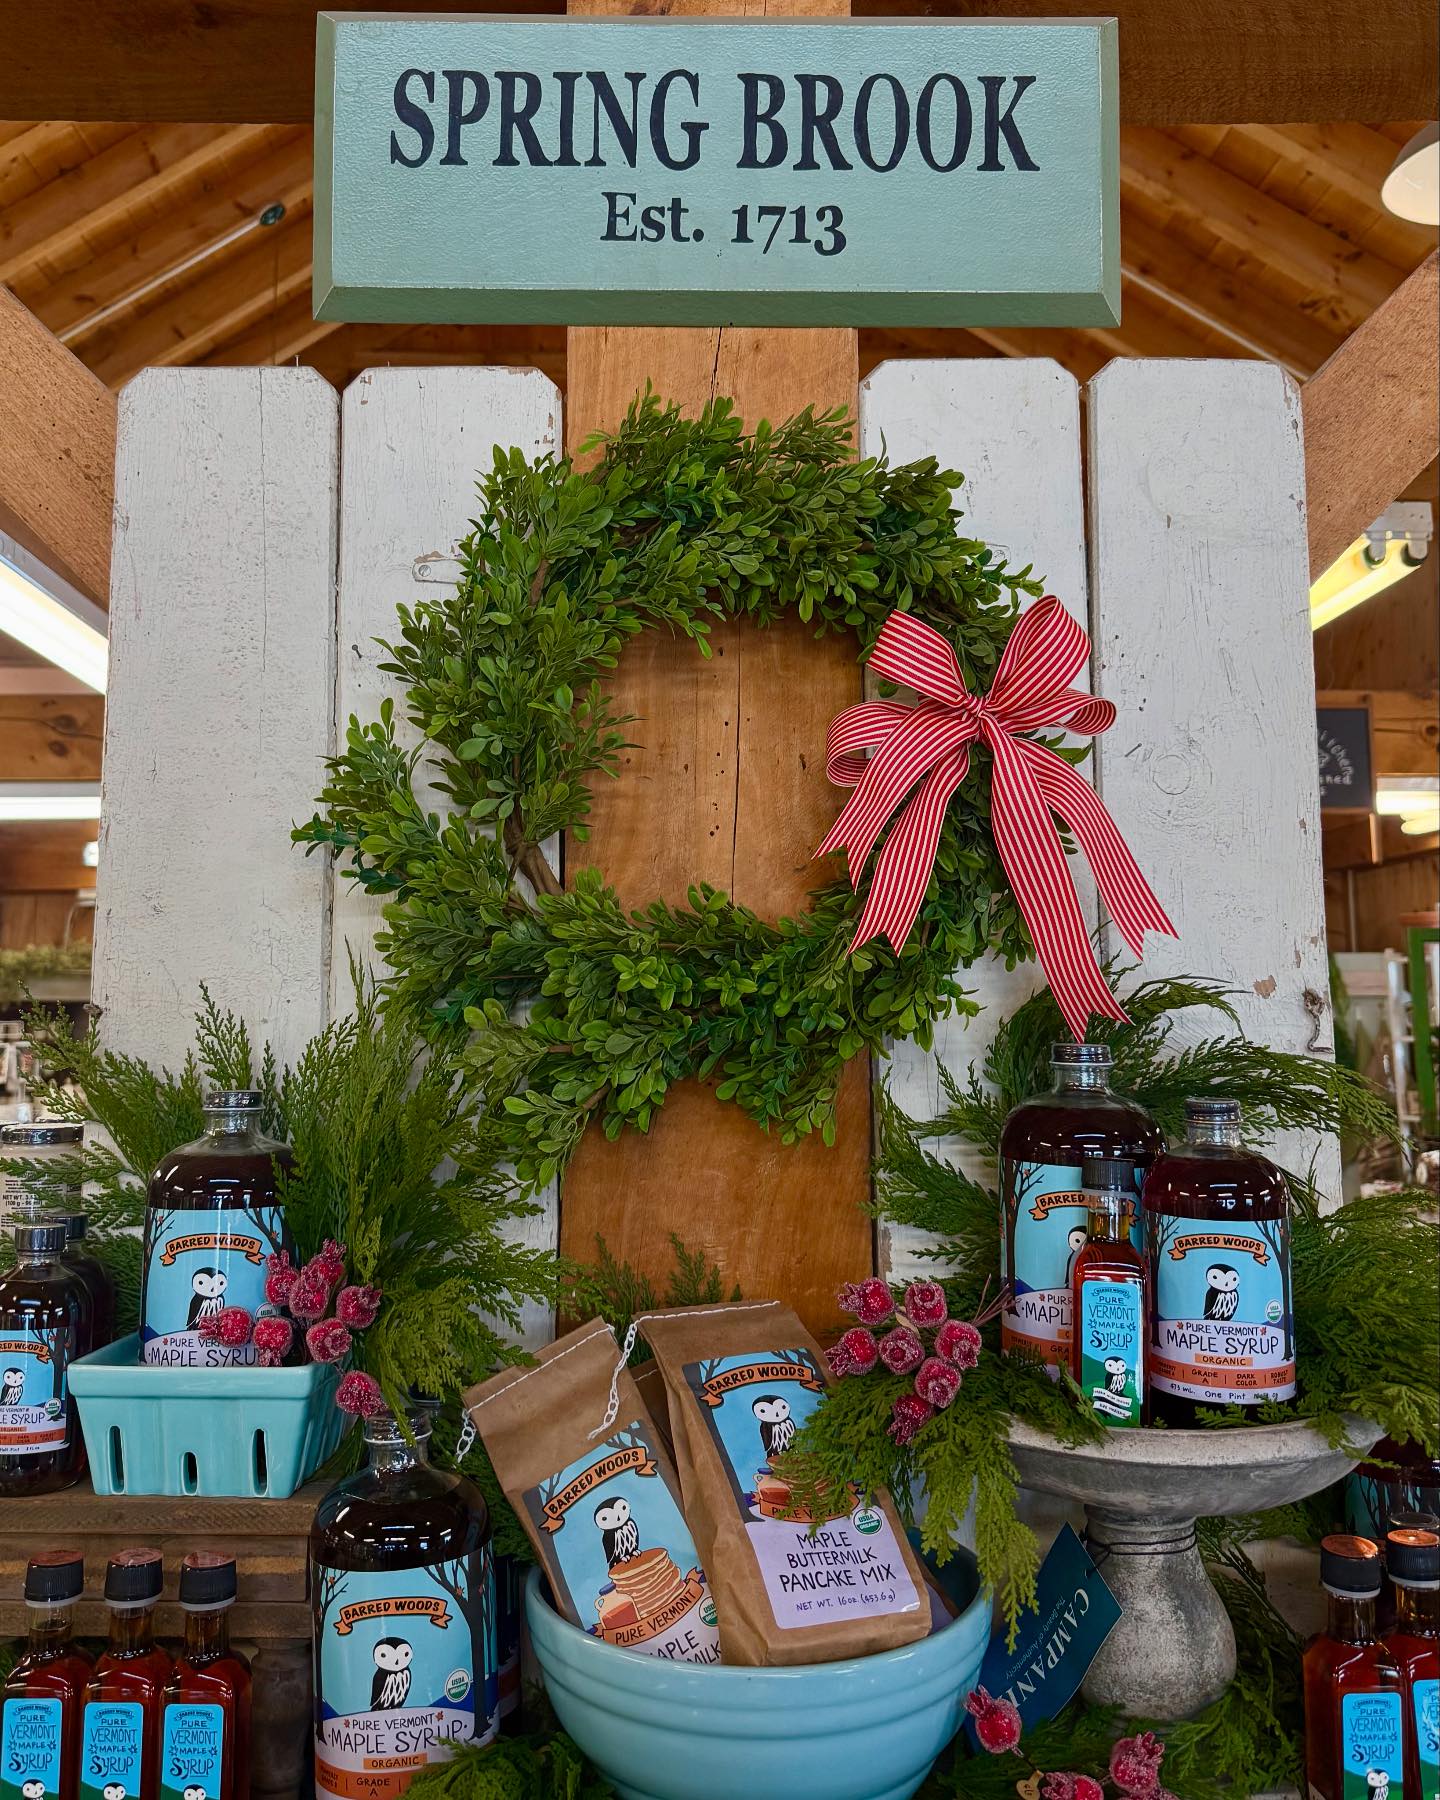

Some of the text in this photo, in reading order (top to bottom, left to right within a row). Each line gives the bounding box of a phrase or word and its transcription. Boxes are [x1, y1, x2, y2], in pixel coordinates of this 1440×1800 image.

[391, 68, 1040, 172] SPRING BROOK
[600, 191, 847, 256] Est. 1713
[1040, 1193, 1086, 1207] BARRED
[168, 1236, 256, 1252] BARRED WOODS
[1178, 1236, 1261, 1251] BARRED WOODS
[1099, 1296, 1124, 1304] PURE
[1025, 1300, 1073, 1326] MAPL
[1088, 1303, 1136, 1321] VERMONT
[1098, 1321, 1125, 1329] MAPLE
[1186, 1321, 1260, 1337] PURE VERMONT
[14, 1341, 45, 1353] WOODS
[169, 1338, 194, 1347] PURE
[1090, 1330, 1133, 1351] SYRUP
[1166, 1328, 1279, 1355] MAPLE SYRUP
[150, 1347, 256, 1367] MAPLE SYRU
[1202, 1355, 1247, 1366] ORGANIC
[708, 1366, 806, 1392] BARRED WOODS
[1191, 1368, 1219, 1378] GRADE
[1204, 1390, 1222, 1399] One
[1229, 1392, 1246, 1400] Pint
[11, 1411, 46, 1425] SYRUP
[548, 1450, 640, 1515] BARRED WOODS
[796, 1531, 852, 1549] MAPLE
[786, 1546, 878, 1569] BUTTERMILK
[779, 1563, 897, 1593] PANCAKE MIX
[343, 1600, 440, 1620] BARRED WOODS
[796, 1601, 813, 1611] NET
[817, 1598, 834, 1608] WT.
[615, 1589, 697, 1644] PURE VERMONT
[650, 1630, 699, 1660] APLE
[1000, 1588, 1090, 1708] CAMPANI
[451, 1677, 465, 1686] USDA
[1360, 1708, 1386, 1716] PURE
[101, 1718, 127, 1726] PURE
[181, 1720, 207, 1728] PURE
[352, 1713, 435, 1731] PURE VERMONT
[1350, 1717, 1396, 1732] VERMONT
[9, 1724, 57, 1739] VERMONT
[90, 1727, 137, 1743] VERMONT
[170, 1729, 217, 1745] VERMONT
[18, 1741, 46, 1749] MAPLE
[330, 1727, 387, 1754] MAPLE
[179, 1747, 207, 1755] MAPLE
[1352, 1743, 1395, 1764] SYRUP
[8, 1752, 53, 1774] SYRUP
[89, 1755, 134, 1777] SYRUP
[169, 1757, 214, 1780] SYRUP
[371, 1756, 420, 1768] ORGANIC
[356, 1777, 391, 1786] GRADE
[369, 1787, 378, 1797] A
